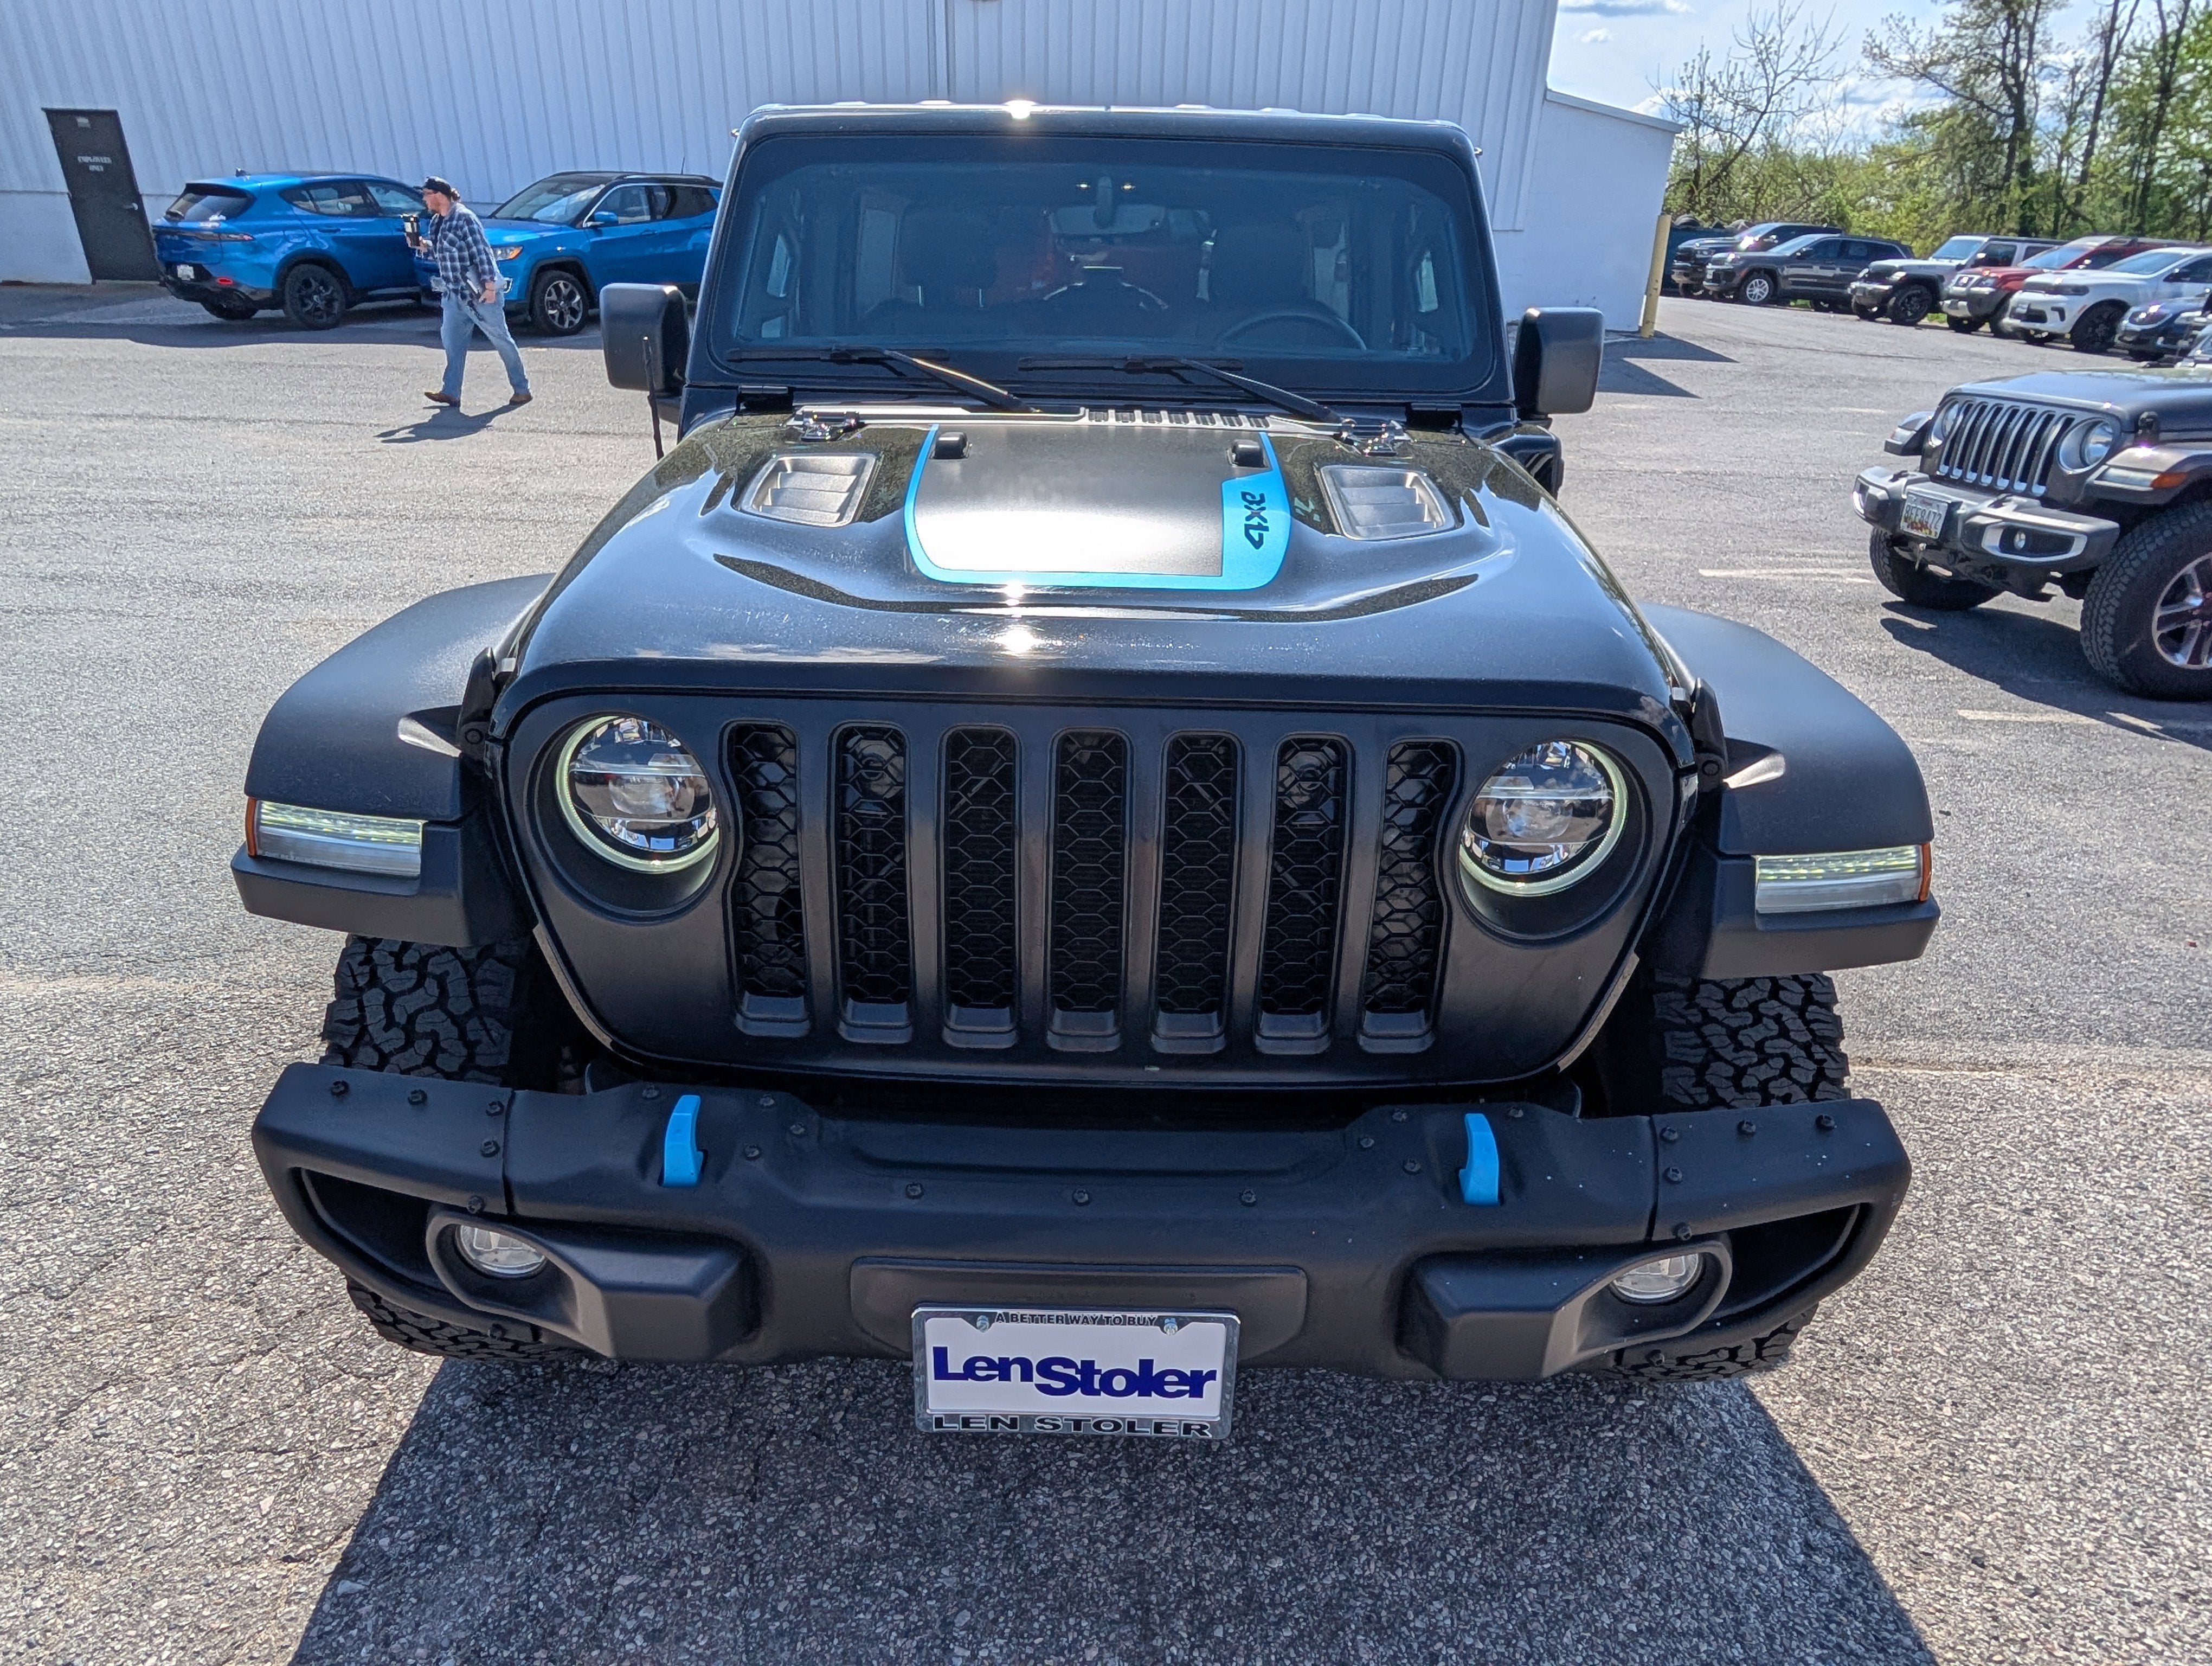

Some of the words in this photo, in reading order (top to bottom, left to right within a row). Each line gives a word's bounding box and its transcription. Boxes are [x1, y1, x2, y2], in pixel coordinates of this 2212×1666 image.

[995, 1312, 1005, 1323] A
[1009, 1313, 1064, 1325] BETTER
[1069, 1314, 1099, 1325] WAY
[1103, 1315, 1123, 1326] TO
[1127, 1315, 1156, 1327] BUY
[933, 1414, 1020, 1432] LEN
[1033, 1415, 1213, 1438] STOLER
